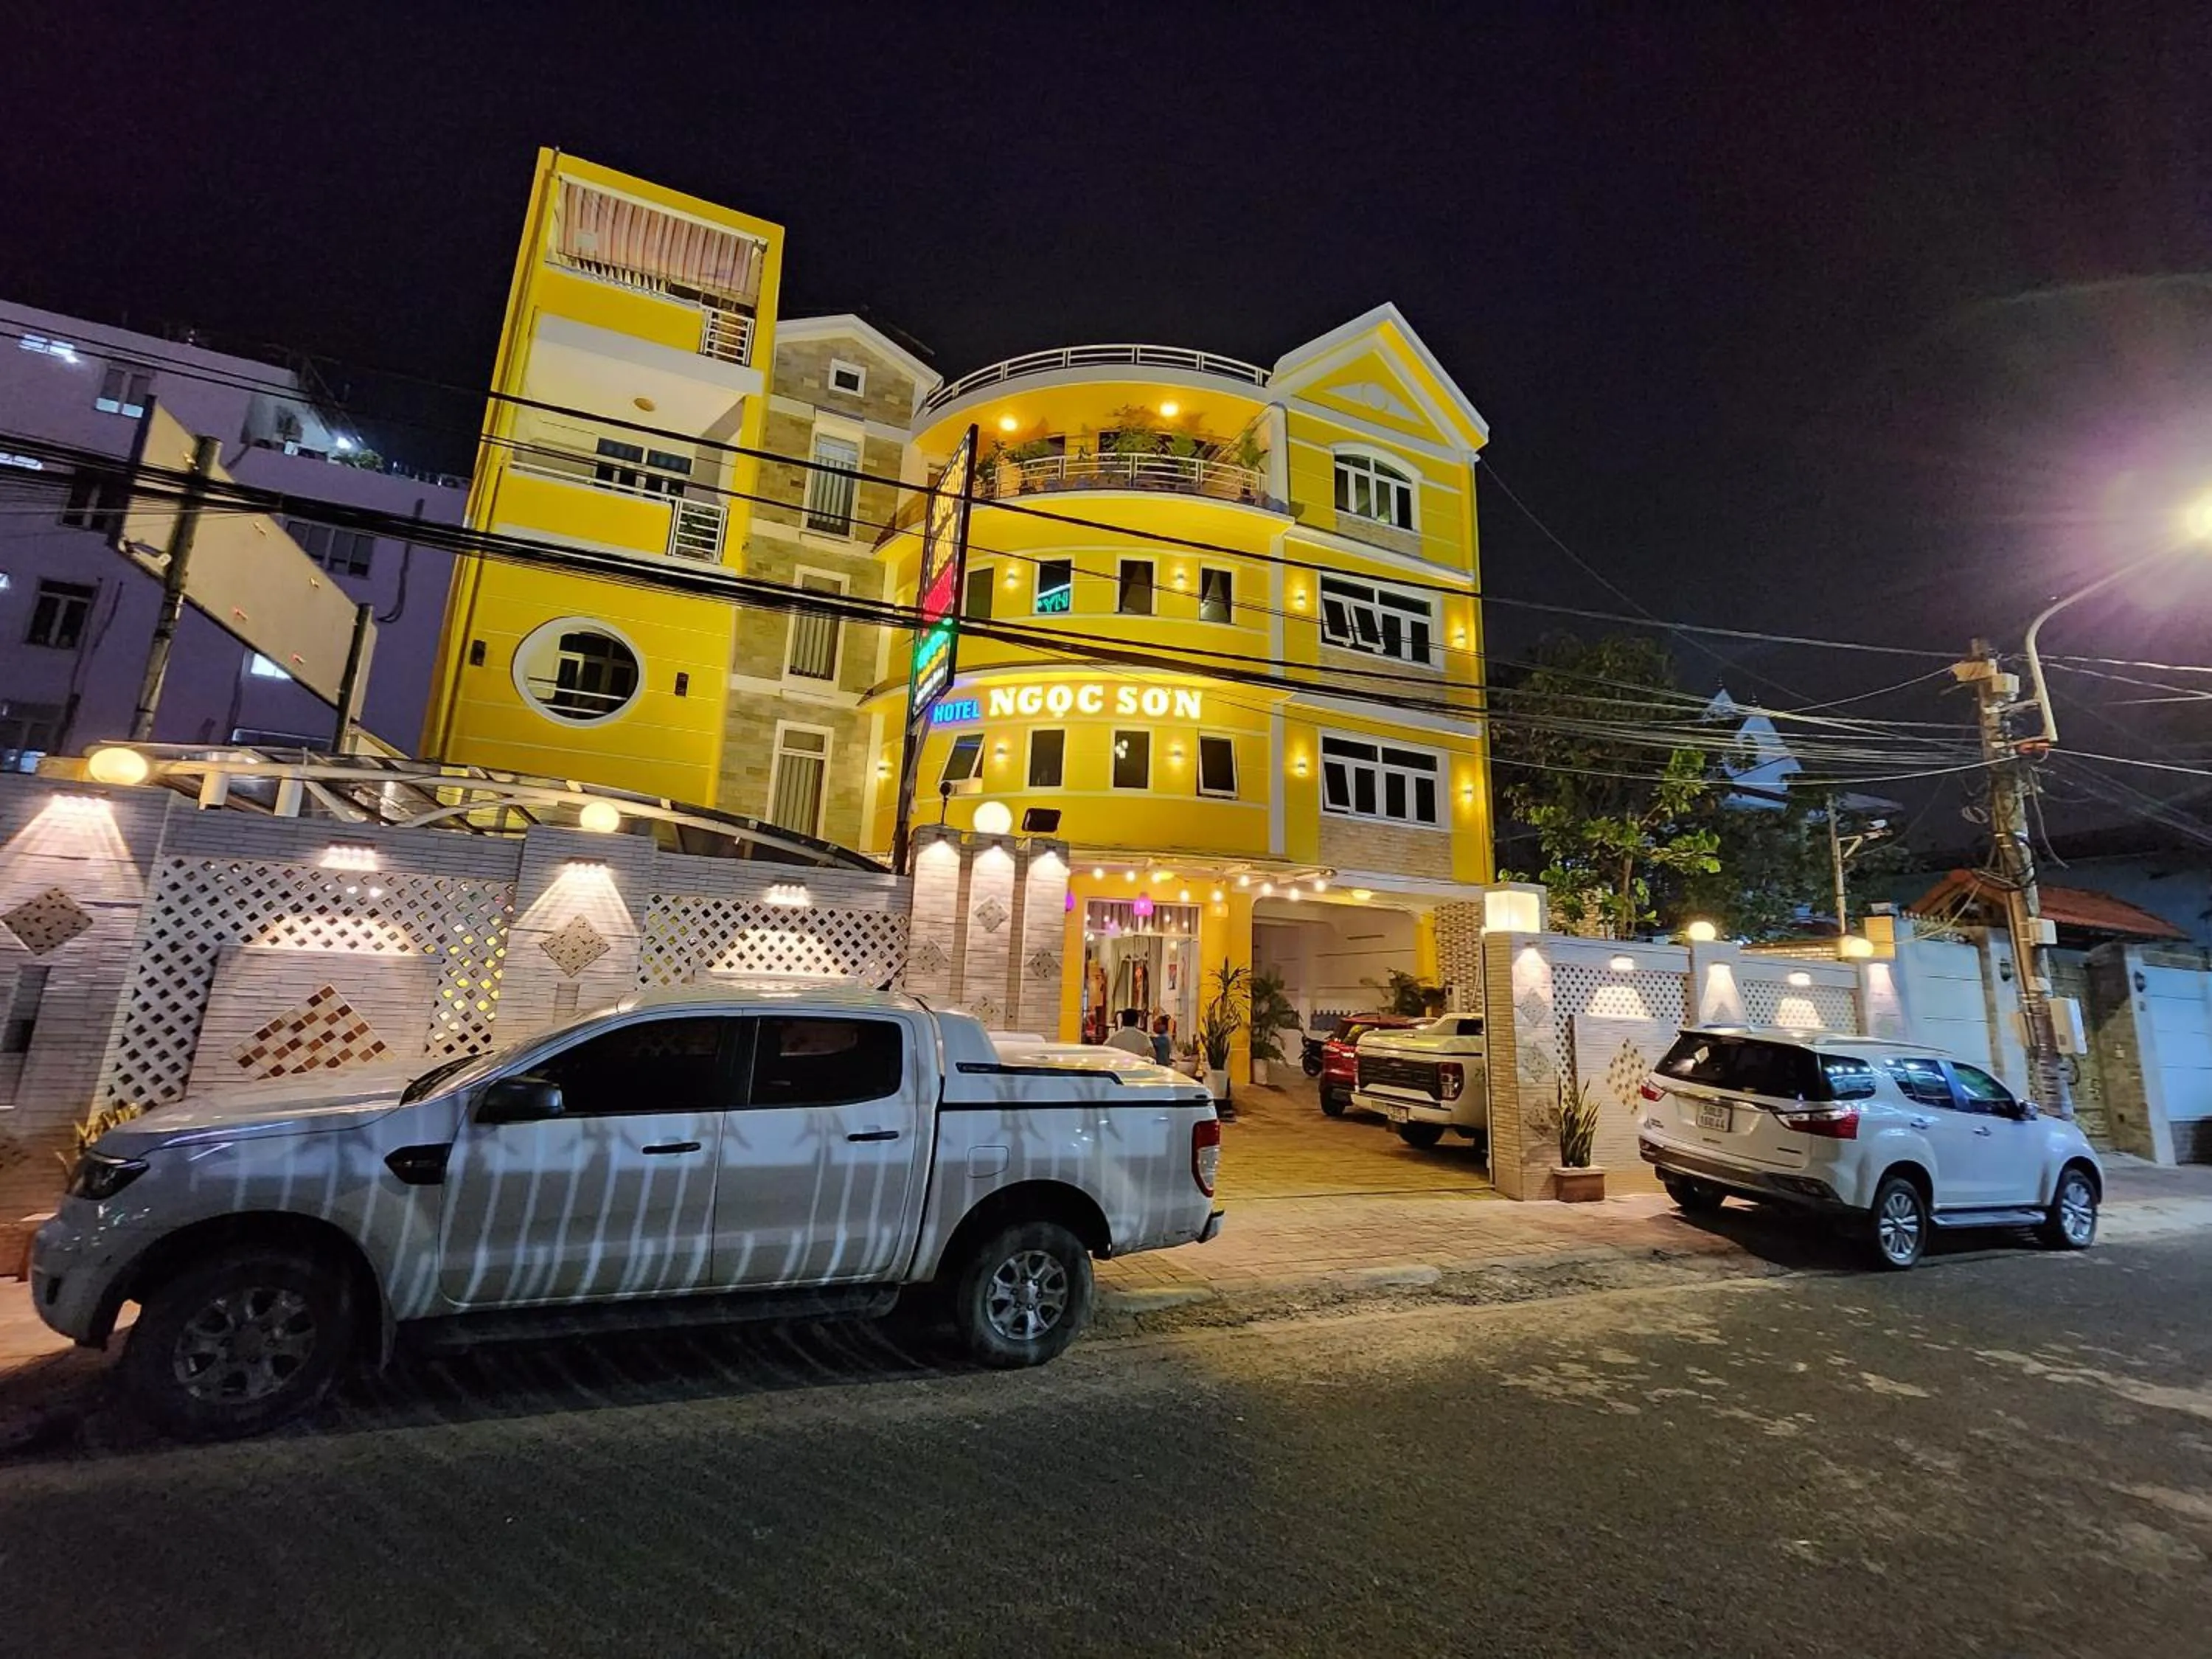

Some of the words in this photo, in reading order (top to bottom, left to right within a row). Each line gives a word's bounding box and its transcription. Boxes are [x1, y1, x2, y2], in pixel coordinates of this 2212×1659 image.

[932, 699, 981, 723] HOTEL
[989, 684, 1105, 718] NGỌC
[1116, 686, 1203, 720] SƠN
